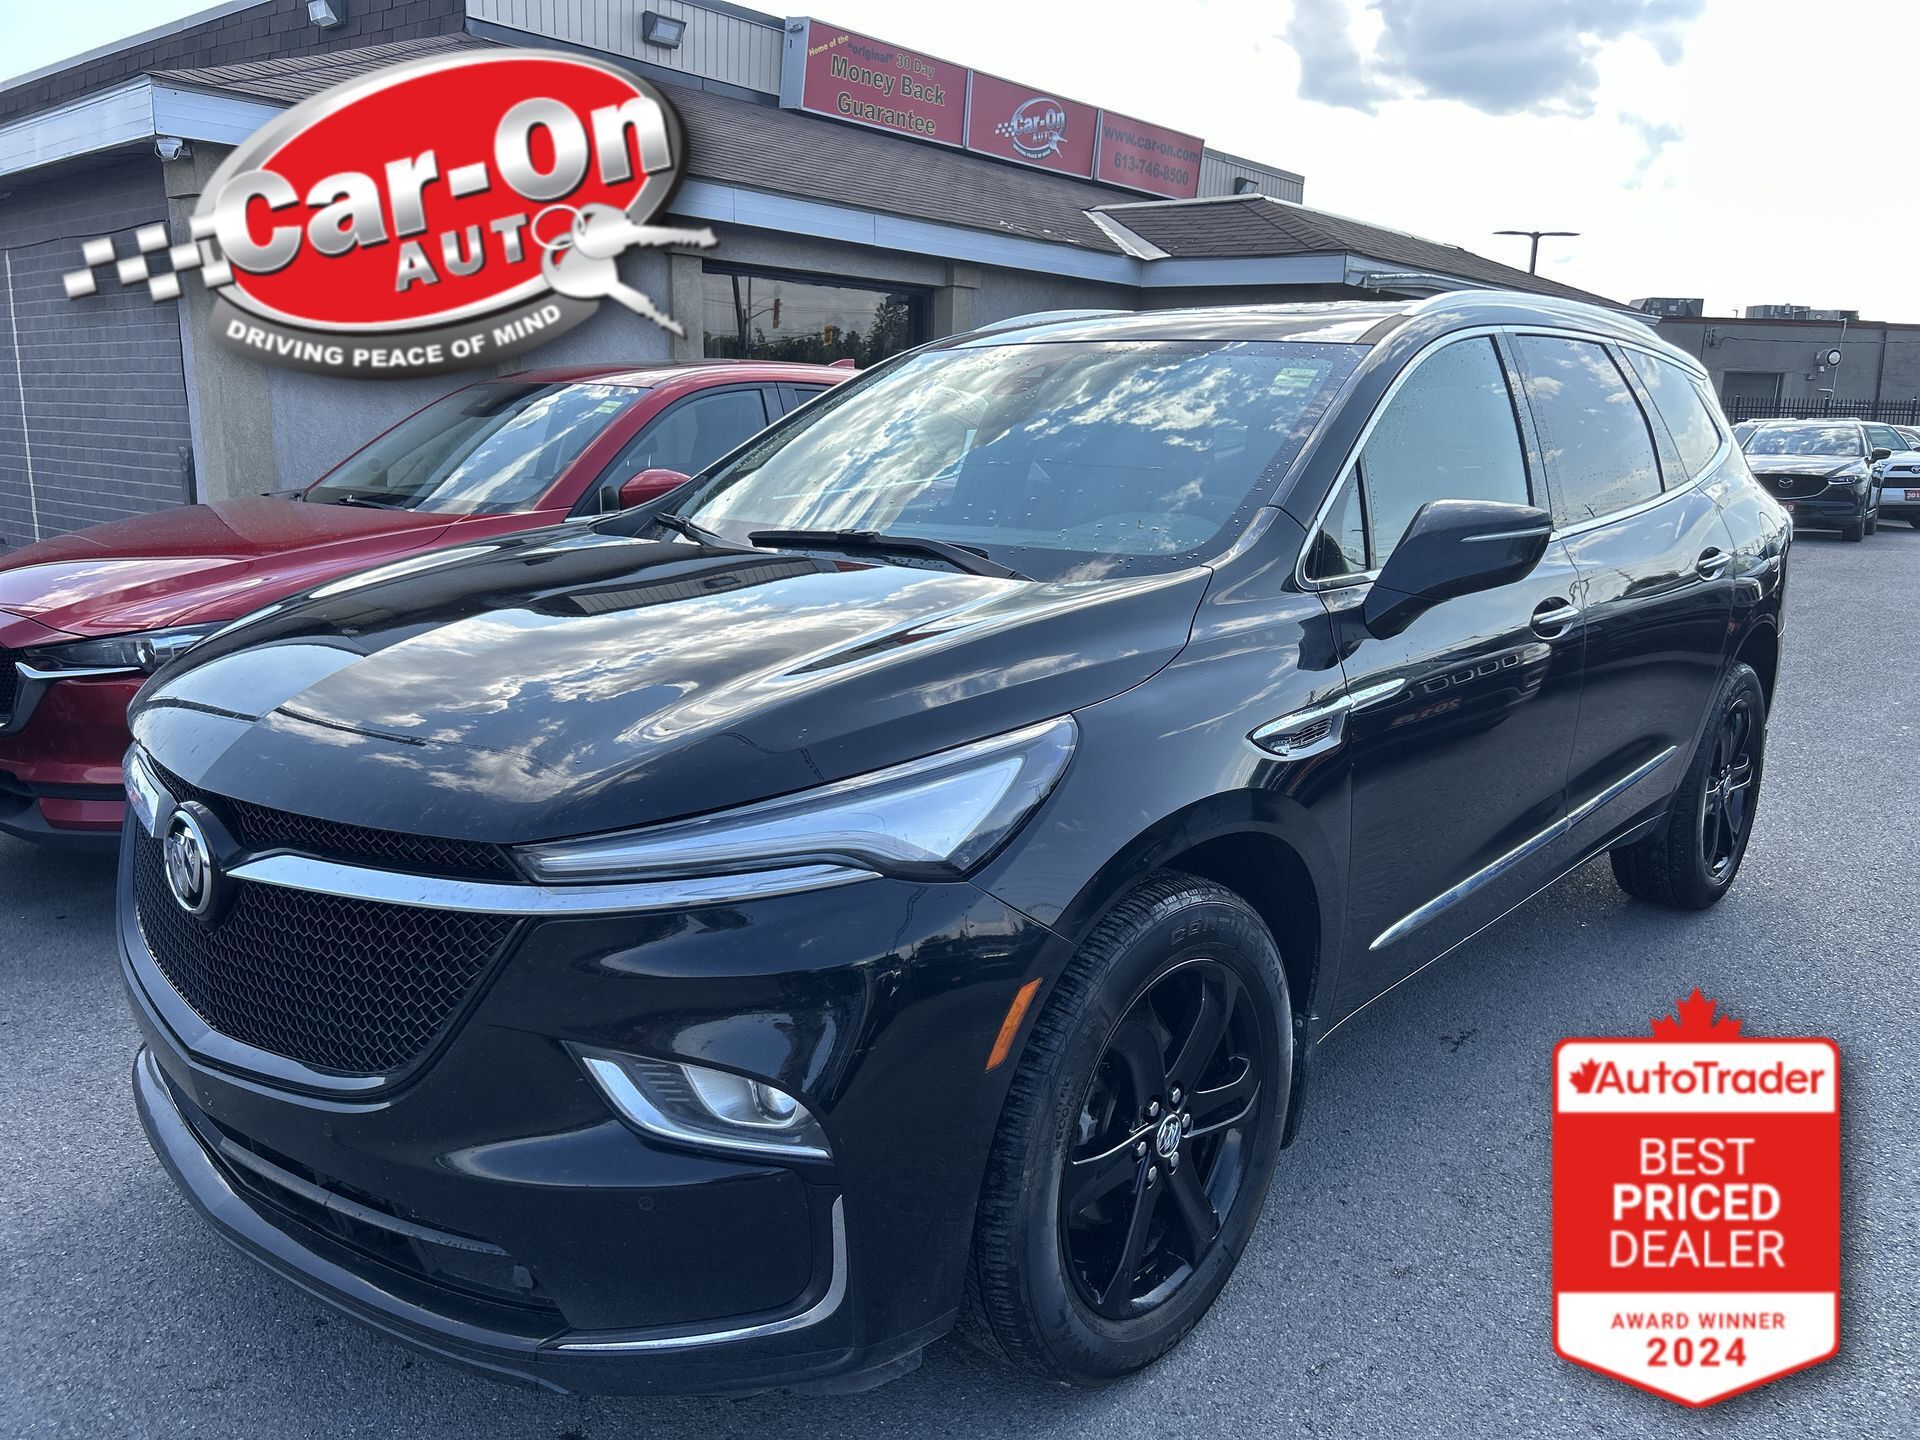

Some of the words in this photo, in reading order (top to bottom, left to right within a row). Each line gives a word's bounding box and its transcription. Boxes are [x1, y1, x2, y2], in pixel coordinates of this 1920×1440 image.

[808, 43, 829, 57] Home
[829, 37, 837, 48] of
[838, 34, 849, 45] the
[831, 54, 896, 97] Money
[901, 75, 945, 106] Back
[896, 54, 911, 69] 30
[914, 59, 935, 80] Day
[837, 92, 936, 135] Guarantee
[1014, 108, 1065, 134] Car-On
[1104, 126, 1199, 164] www.car-on.com
[1114, 152, 1189, 186] 613-746-8500
